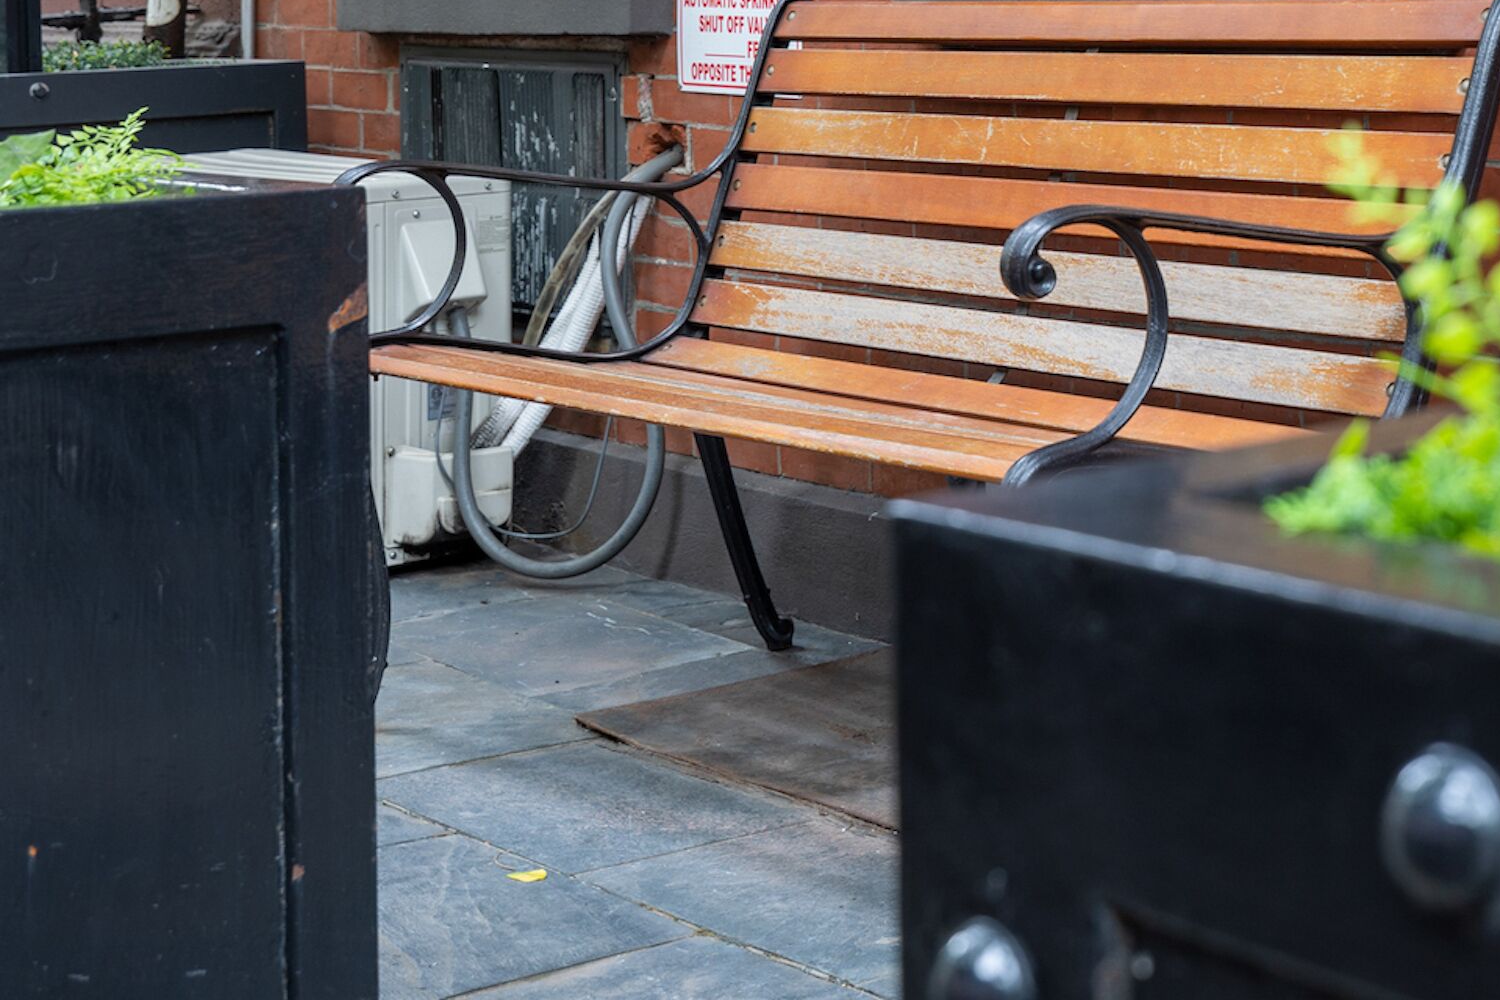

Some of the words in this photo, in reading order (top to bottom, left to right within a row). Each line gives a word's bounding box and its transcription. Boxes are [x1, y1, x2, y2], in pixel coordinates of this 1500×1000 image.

[699, 15, 724, 33] SHUT
[727, 16, 745, 33] OFF
[747, 41, 759, 59] FE
[691, 62, 737, 81] OPPOSITE
[739, 65, 753, 83] TH
